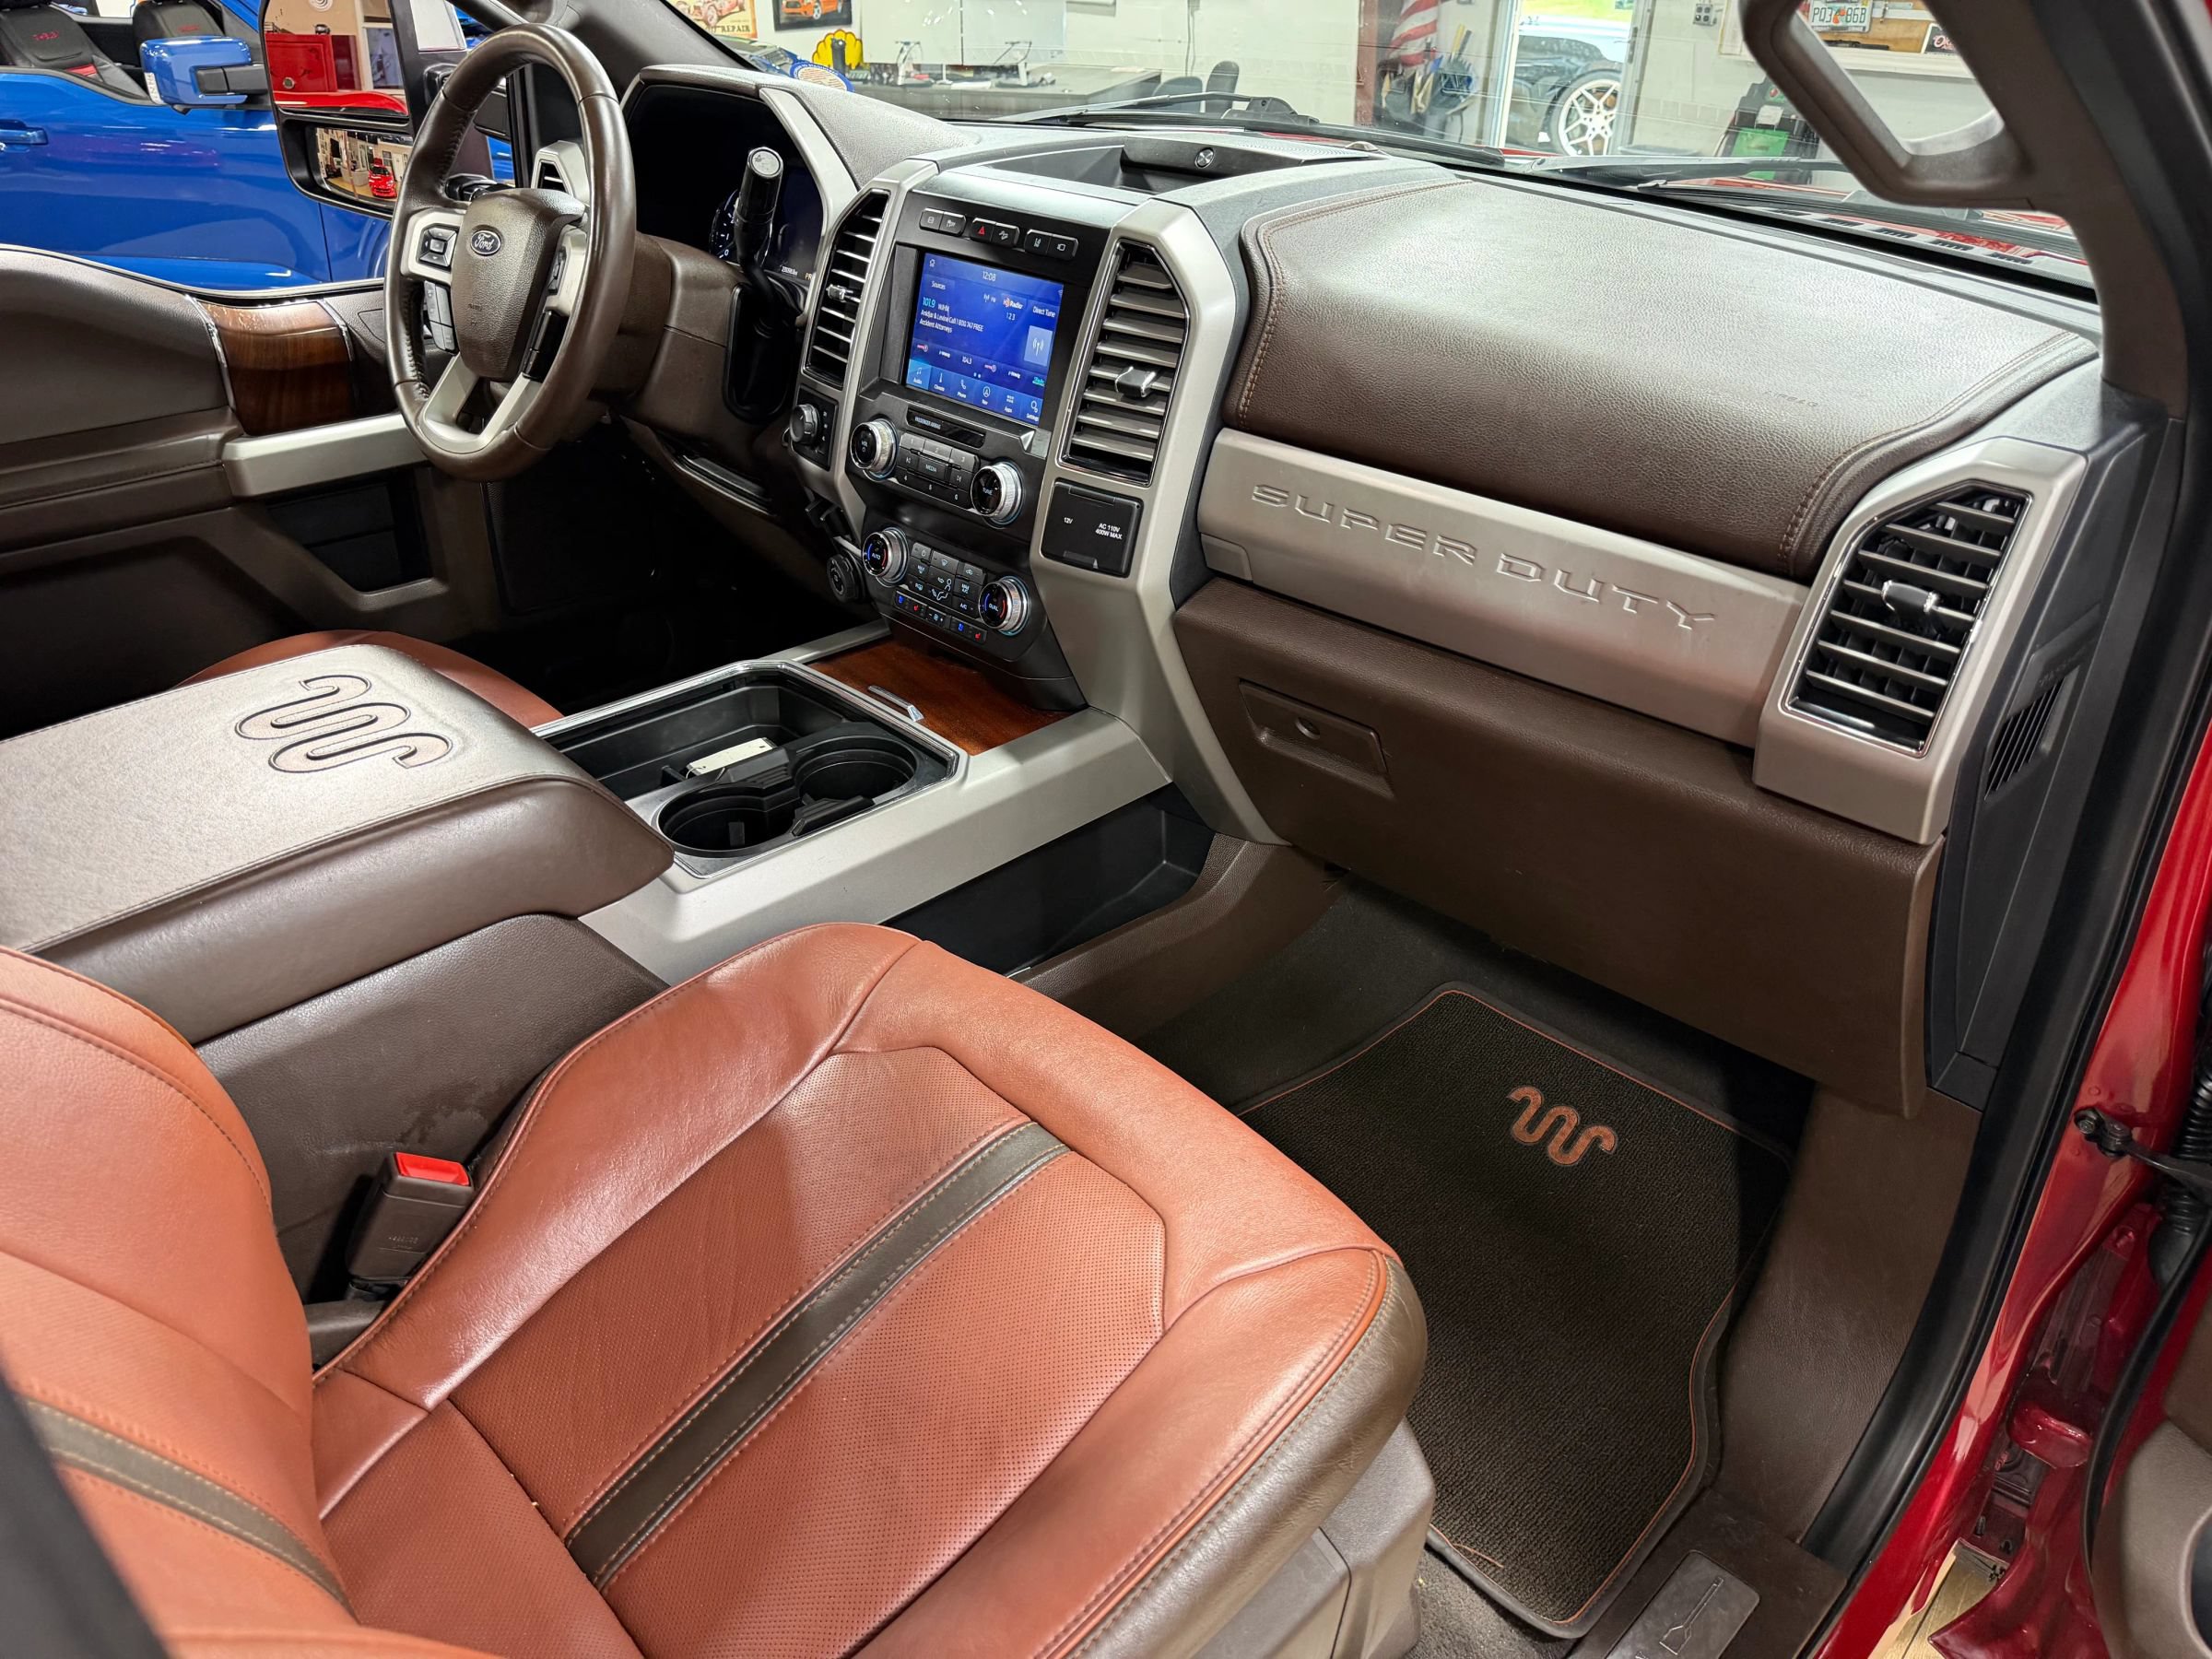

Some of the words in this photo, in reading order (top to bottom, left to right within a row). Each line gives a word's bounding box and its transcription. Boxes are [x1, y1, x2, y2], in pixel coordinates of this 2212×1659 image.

[722, 24, 750, 33] REPAIR
[474, 232, 495, 251] Ford
[931, 280, 947, 290] Sources
[923, 297, 936, 309] 101.9
[1032, 306, 1045, 315] Direct
[1045, 309, 1056, 318] Tune
[920, 318, 935, 328] Accident
[935, 323, 953, 334] Attorneys
[973, 323, 984, 332] FREE
[1762, 390, 1819, 408] AIRBAG
[925, 464, 937, 473] MEDIA
[1095, 528, 1110, 537] 400W
[1109, 531, 1123, 540] MAX
[1107, 524, 1121, 533] 110V
[1251, 483, 1477, 566] SUPER
[1495, 551, 1717, 631] DUTY
